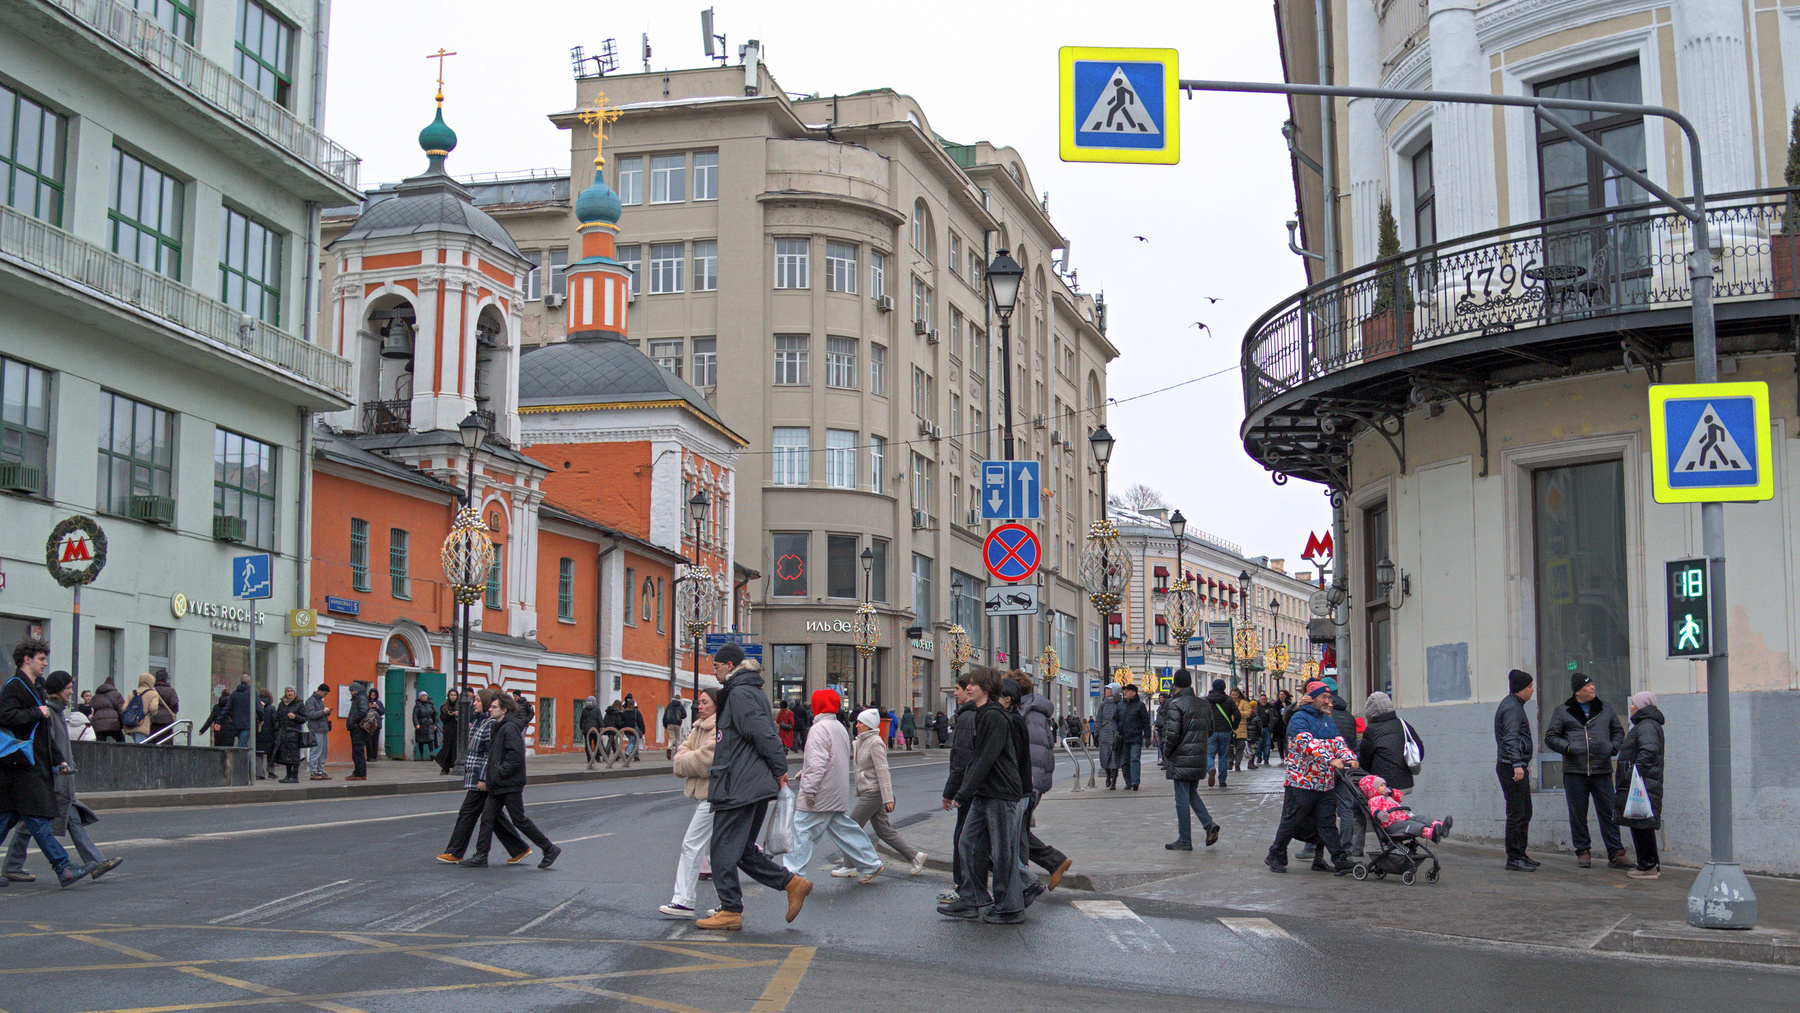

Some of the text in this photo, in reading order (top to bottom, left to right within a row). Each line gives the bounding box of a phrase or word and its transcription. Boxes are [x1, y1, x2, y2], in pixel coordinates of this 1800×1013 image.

[1461, 259, 1539, 299] 1796
[1682, 569, 1703, 597] 18
[188, 600, 217, 617] YVES
[353, 602, 358, 611] 5
